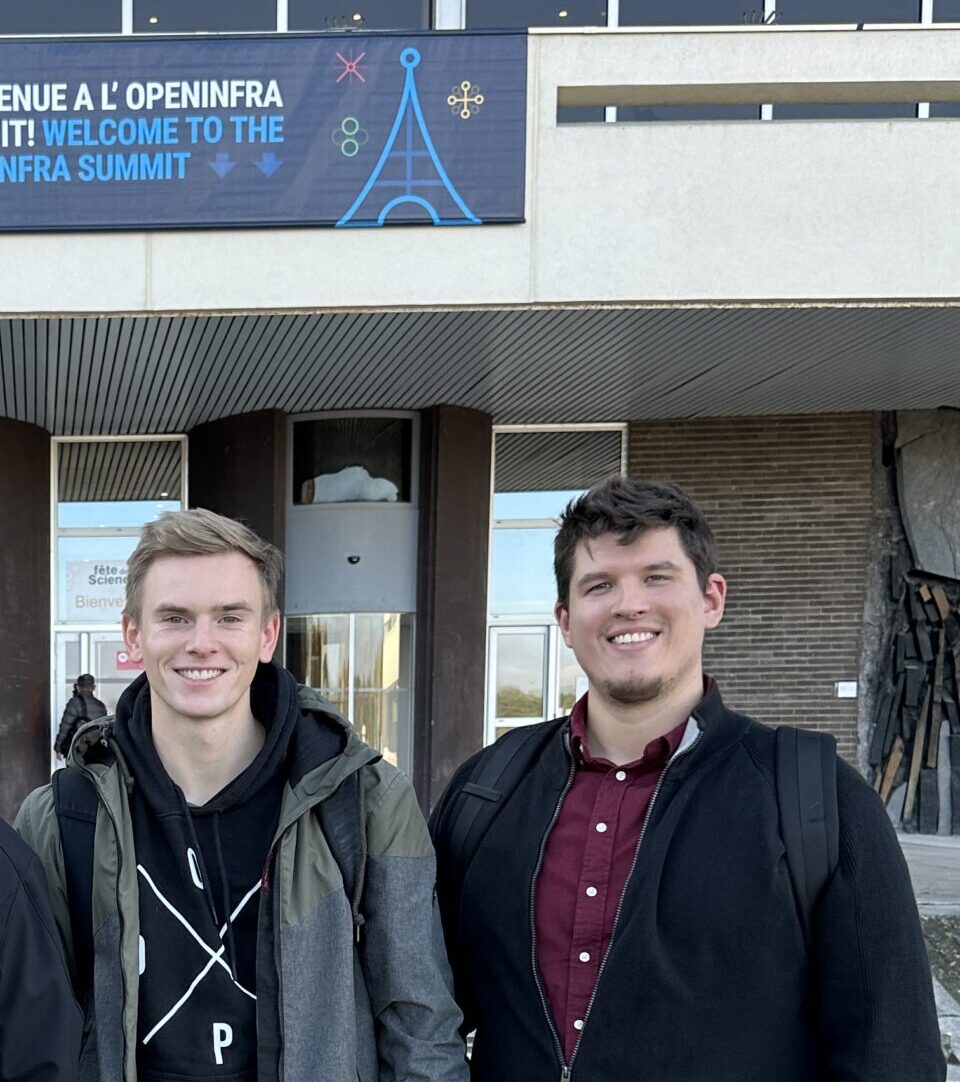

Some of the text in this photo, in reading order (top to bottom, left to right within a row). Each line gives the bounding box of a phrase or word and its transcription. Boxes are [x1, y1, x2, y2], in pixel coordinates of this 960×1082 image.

[73, 82, 94, 111] A
[125, 79, 284, 110] OPENINFRA
[42, 116, 179, 147] WELCOME
[185, 116, 223, 144] TO
[230, 115, 285, 143] THE
[78, 151, 191, 182] SUMMIT
[88, 574, 128, 585] Scienc
[94, 564, 118, 575] fête
[75, 595, 123, 608] Bienve
[212, 1022, 233, 1065] P
